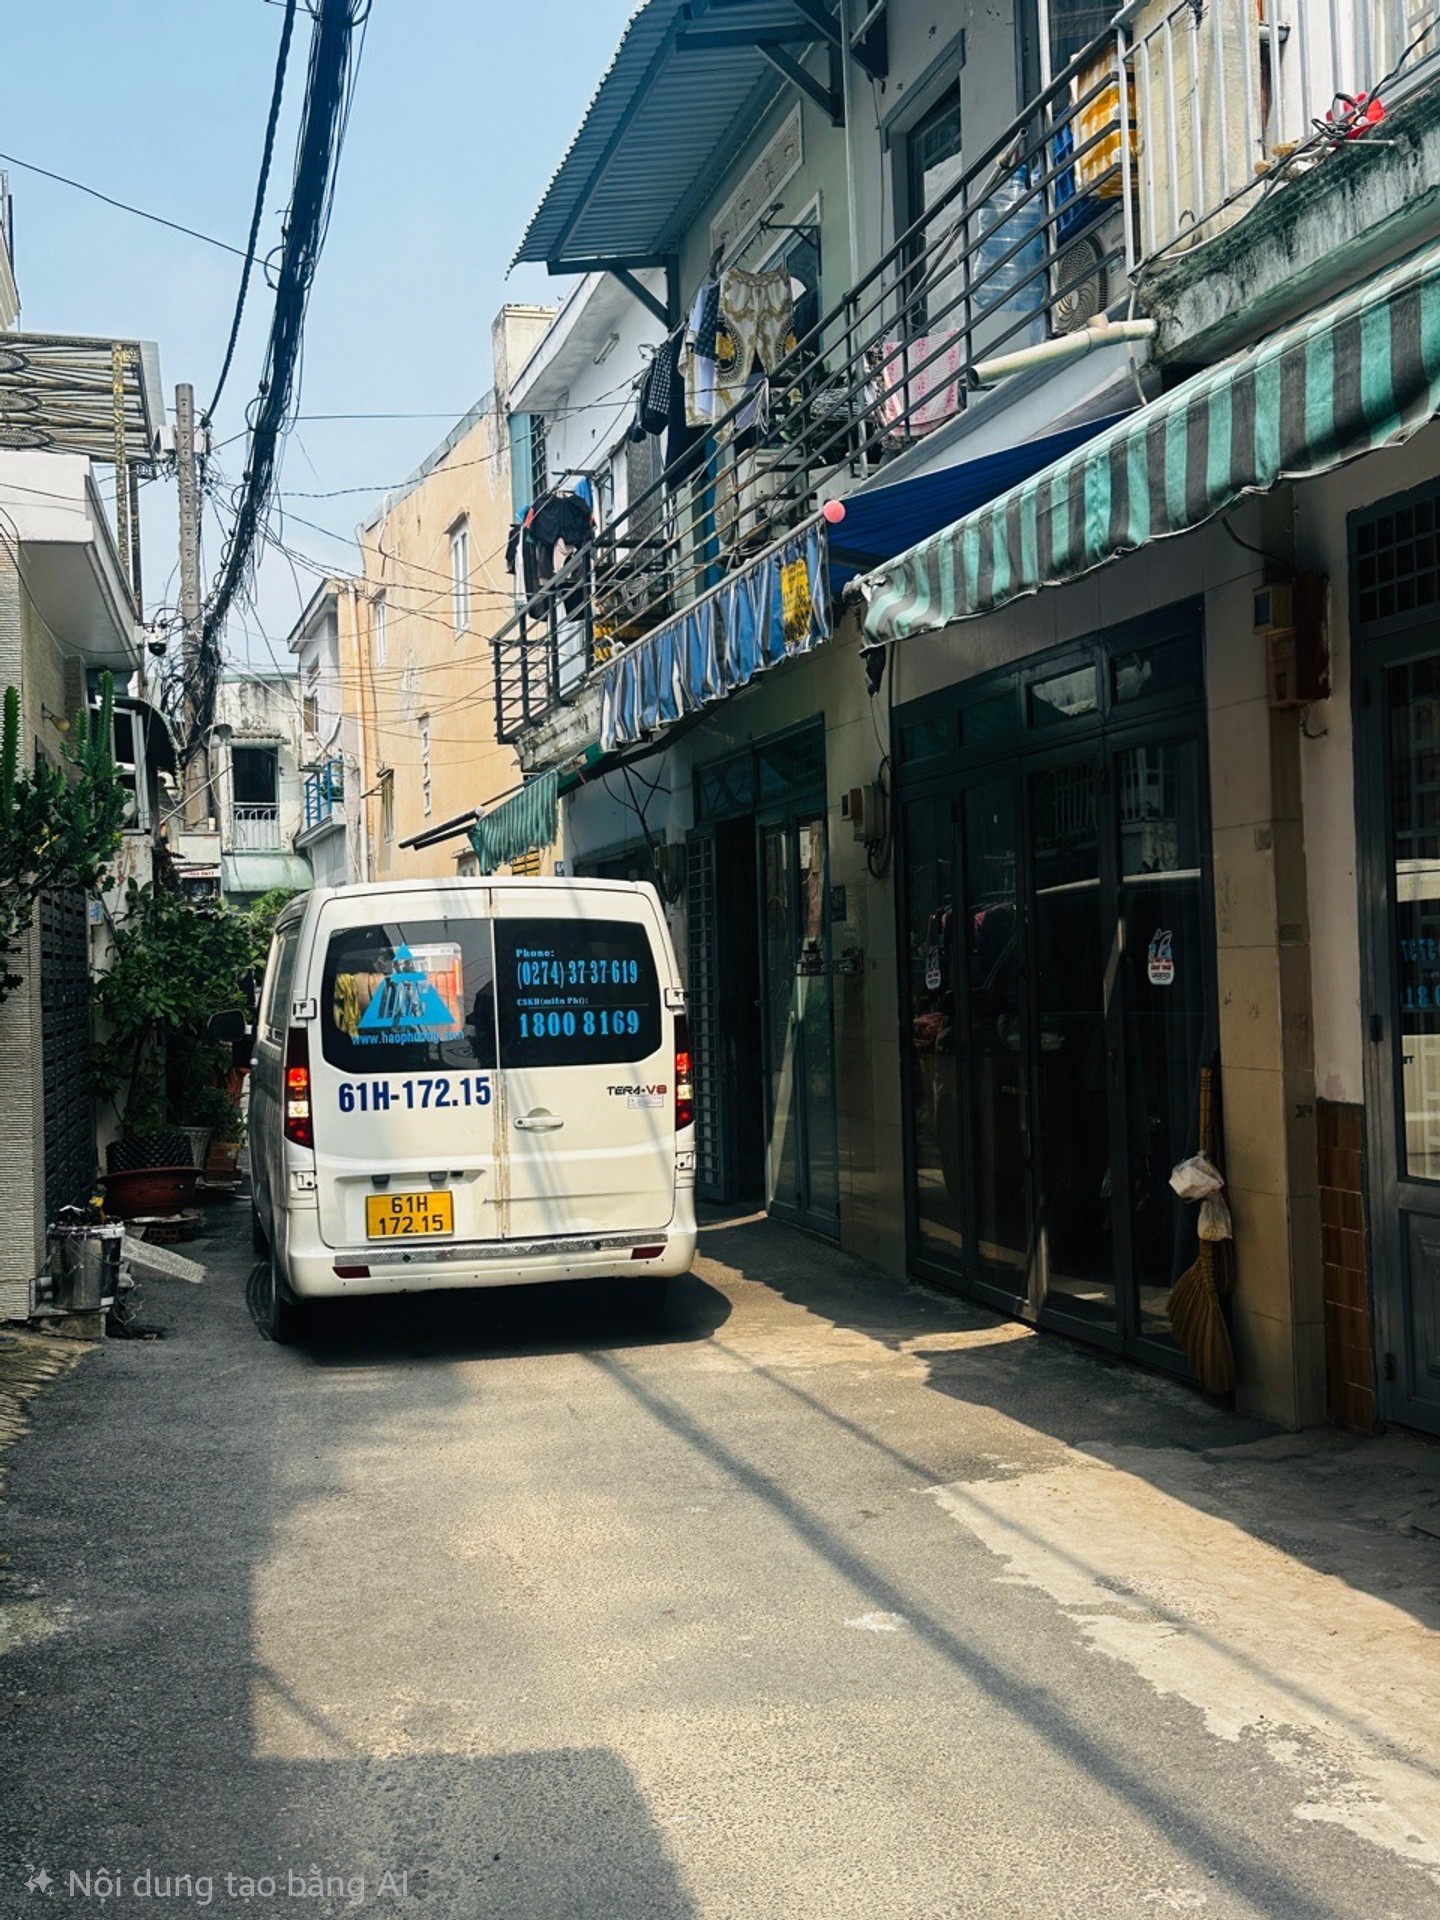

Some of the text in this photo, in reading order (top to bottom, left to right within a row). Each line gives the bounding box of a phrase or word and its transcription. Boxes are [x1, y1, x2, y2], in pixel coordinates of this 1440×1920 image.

[515, 949, 555, 958] Phone:
[517, 960, 638, 989] (0274) 37 37 619
[520, 1010, 639, 1038] 1800 8169
[338, 1076, 491, 1113] 61H-172.15
[391, 1195, 428, 1214] 61H
[379, 1214, 444, 1235] 172.15
